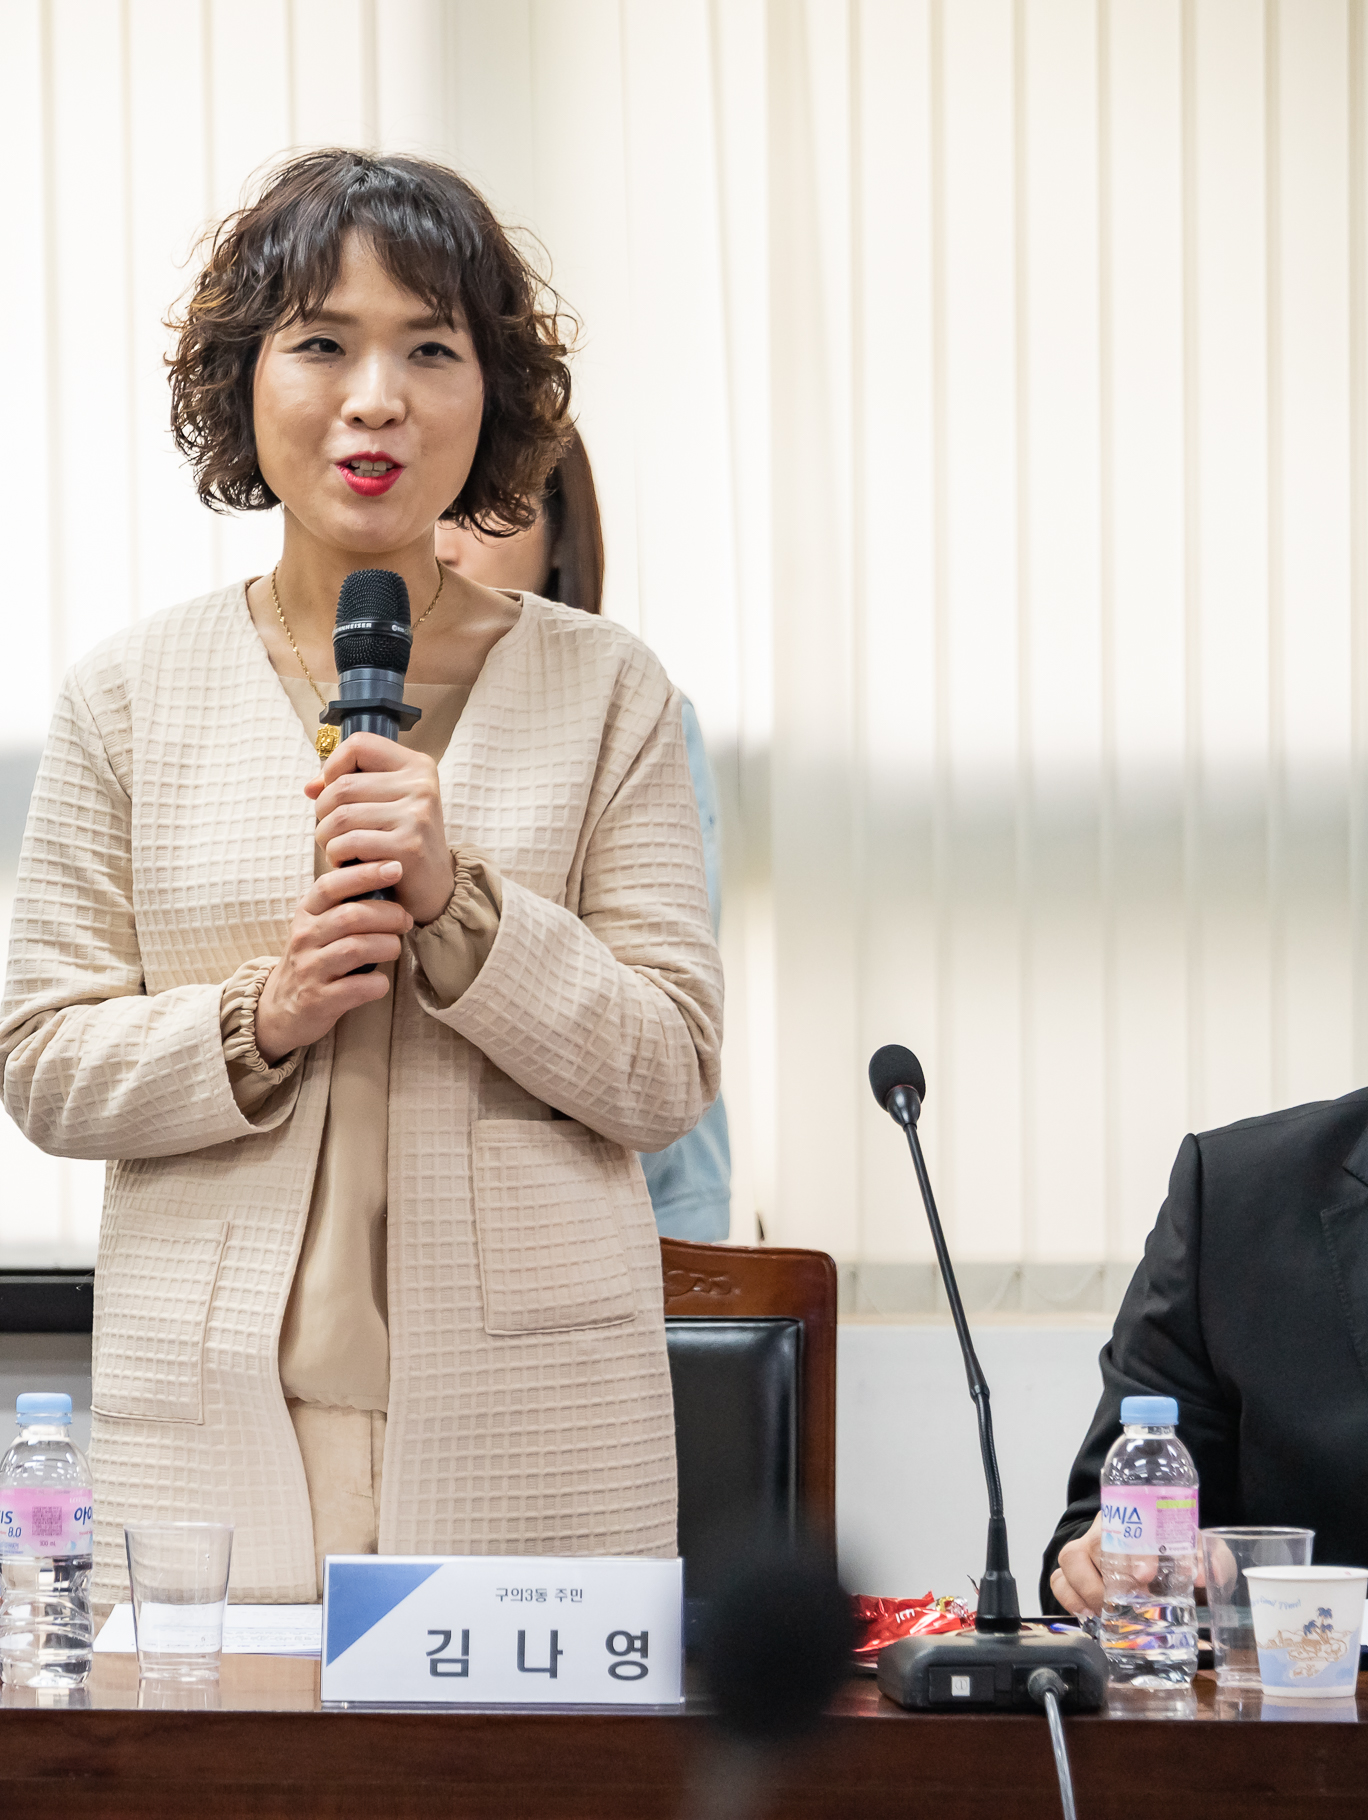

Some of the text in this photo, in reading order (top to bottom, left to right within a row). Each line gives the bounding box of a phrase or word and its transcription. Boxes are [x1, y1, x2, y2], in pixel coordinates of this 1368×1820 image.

[7, 1526, 22, 1538] 8.0
[1123, 1526, 1143, 1539] 8.0
[494, 1587, 584, 1603] 구의3동 주민
